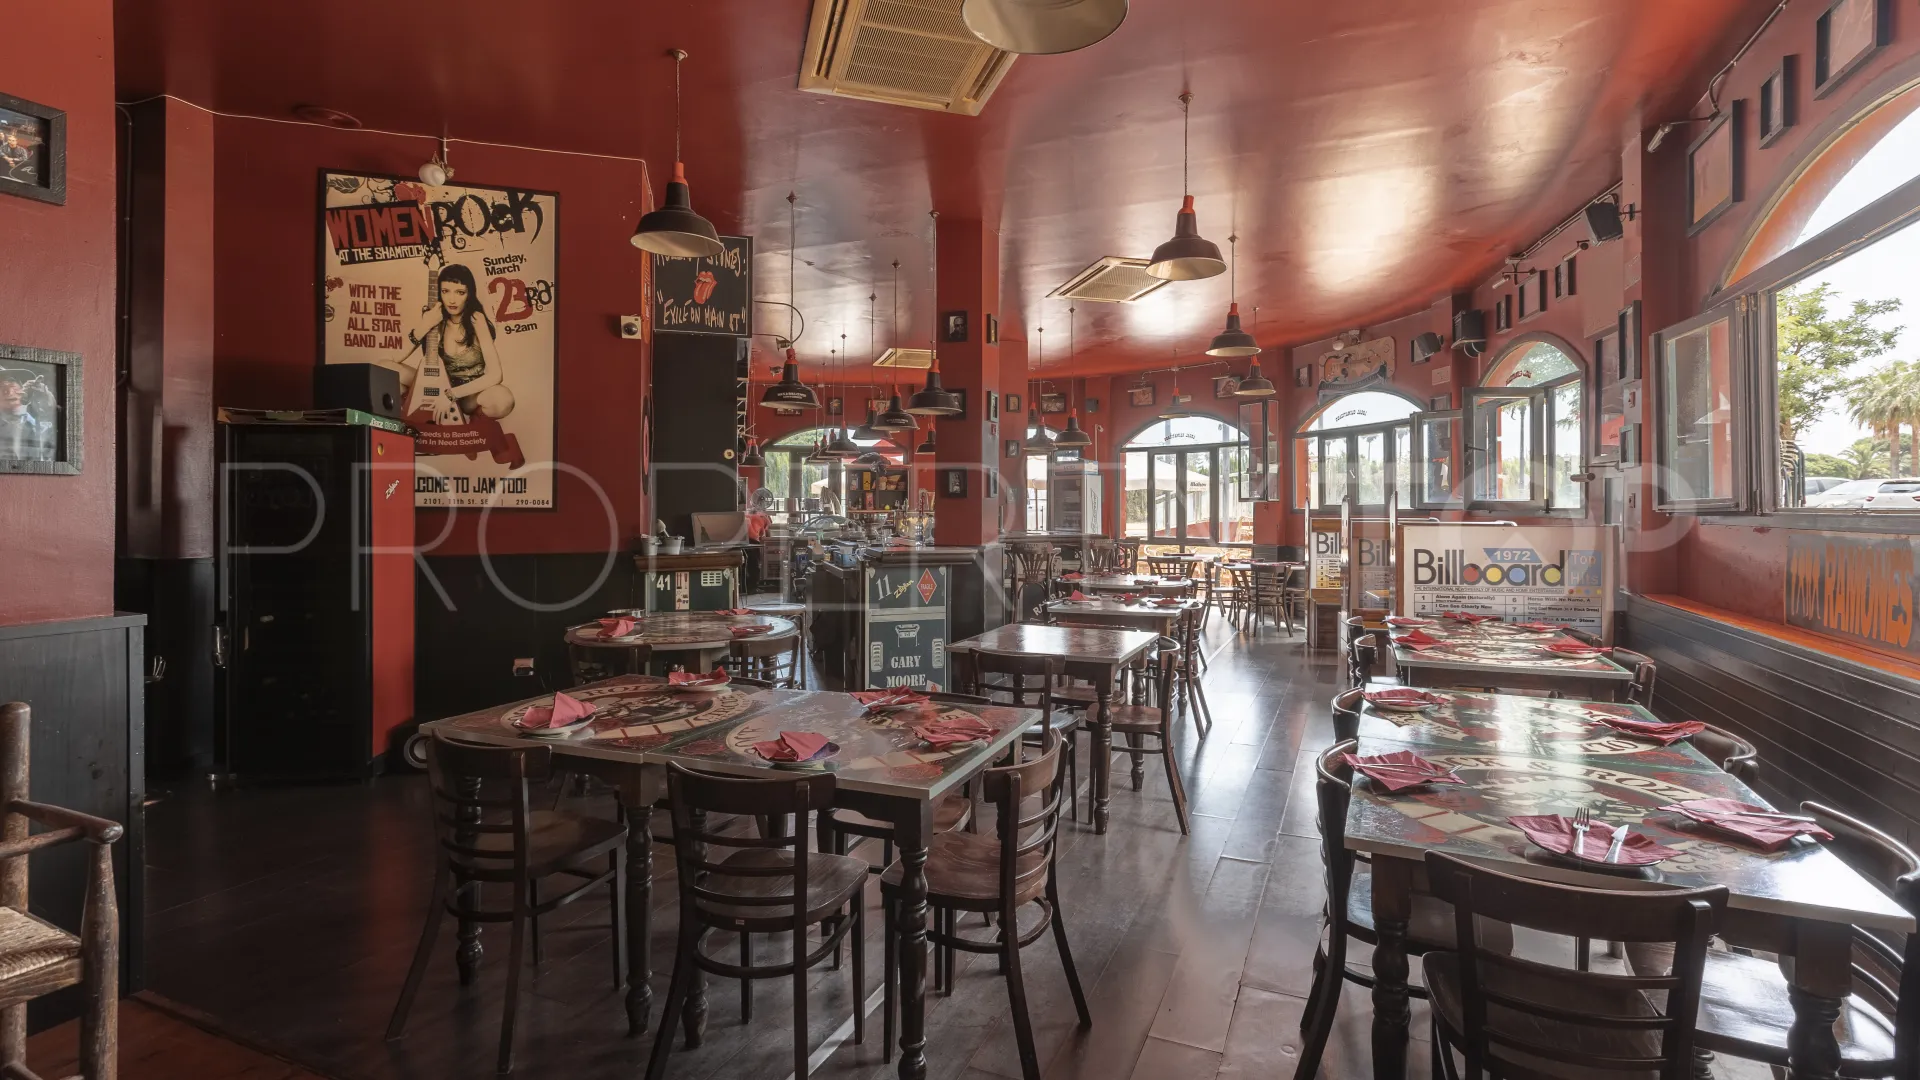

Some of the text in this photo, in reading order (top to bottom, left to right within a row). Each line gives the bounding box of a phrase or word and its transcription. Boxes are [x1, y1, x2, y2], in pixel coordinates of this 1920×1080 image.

[325, 206, 436, 249] WOMEN
[338, 244, 428, 261] AT THE SHAMROCK
[483, 253, 528, 268] Sunday,
[485, 263, 520, 277] March
[349, 283, 402, 301] WITH THE
[350, 300, 401, 317] ALL GIRL
[690, 306, 701, 324] ON
[704, 305, 725, 328] MAIN
[347, 317, 401, 333] ALL STAR
[504, 320, 538, 335] 9-2am
[344, 332, 403, 350] BAND JAM
[459, 437, 487, 446] Society
[415, 477, 527, 493] COME TO JAM TOO!
[1493, 550, 1531, 561] 1972
[1571, 553, 1597, 566] Top
[1414, 548, 1565, 586] Billboard
[656, 574, 671, 591] 41
[875, 574, 892, 601] 11
[1823, 542, 1914, 648] RAMONES
[890, 655, 921, 669] GARY
[886, 674, 926, 688] MOORE
